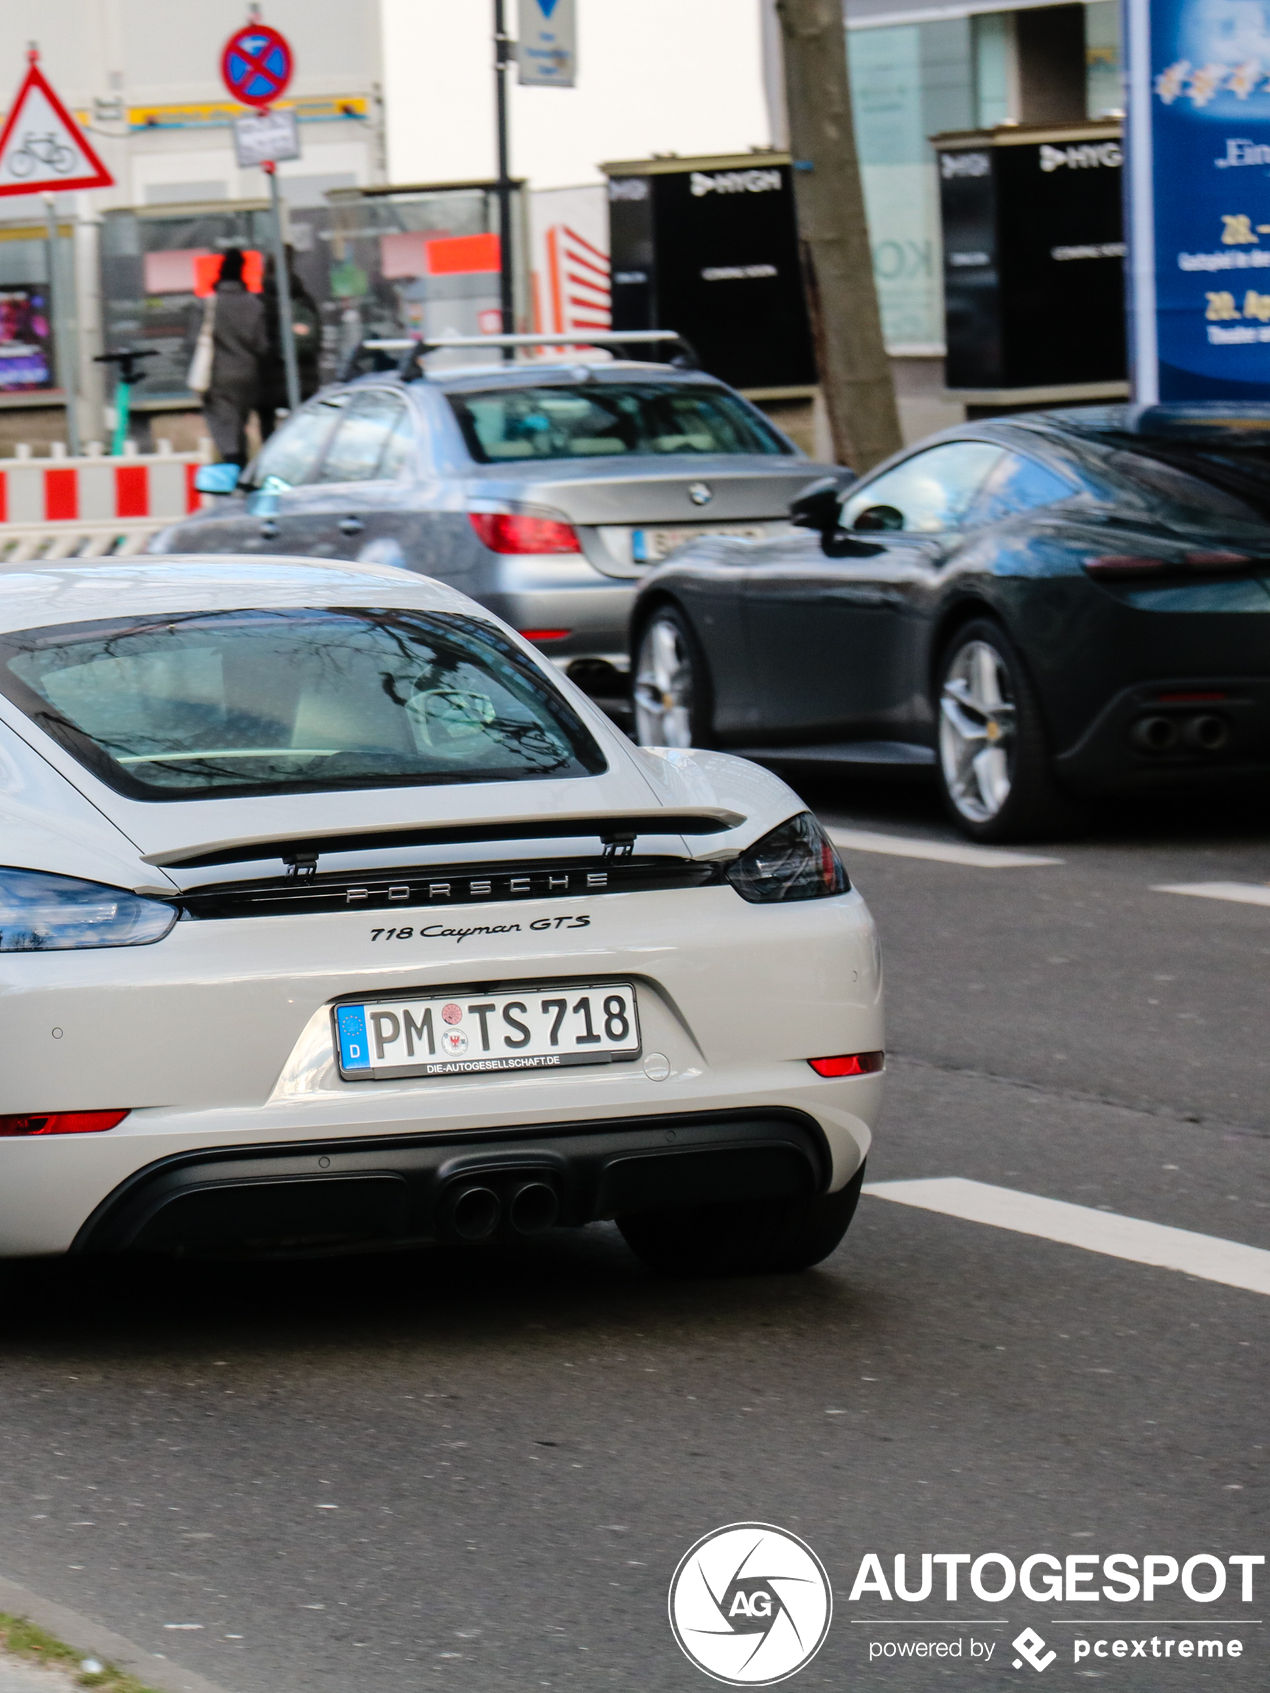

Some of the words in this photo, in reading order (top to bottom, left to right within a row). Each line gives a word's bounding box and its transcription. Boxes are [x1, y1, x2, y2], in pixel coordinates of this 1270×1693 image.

[346, 872, 608, 903] PORSCHE
[370, 926, 414, 942] 718
[420, 923, 522, 943] Cayman
[529, 915, 591, 931] GTS
[370, 1007, 435, 1059] PM
[468, 1001, 532, 1051] TS
[541, 994, 629, 1046] 718
[427, 1054, 561, 1074] DIE-AUTOGESELLSCHAFT.DE
